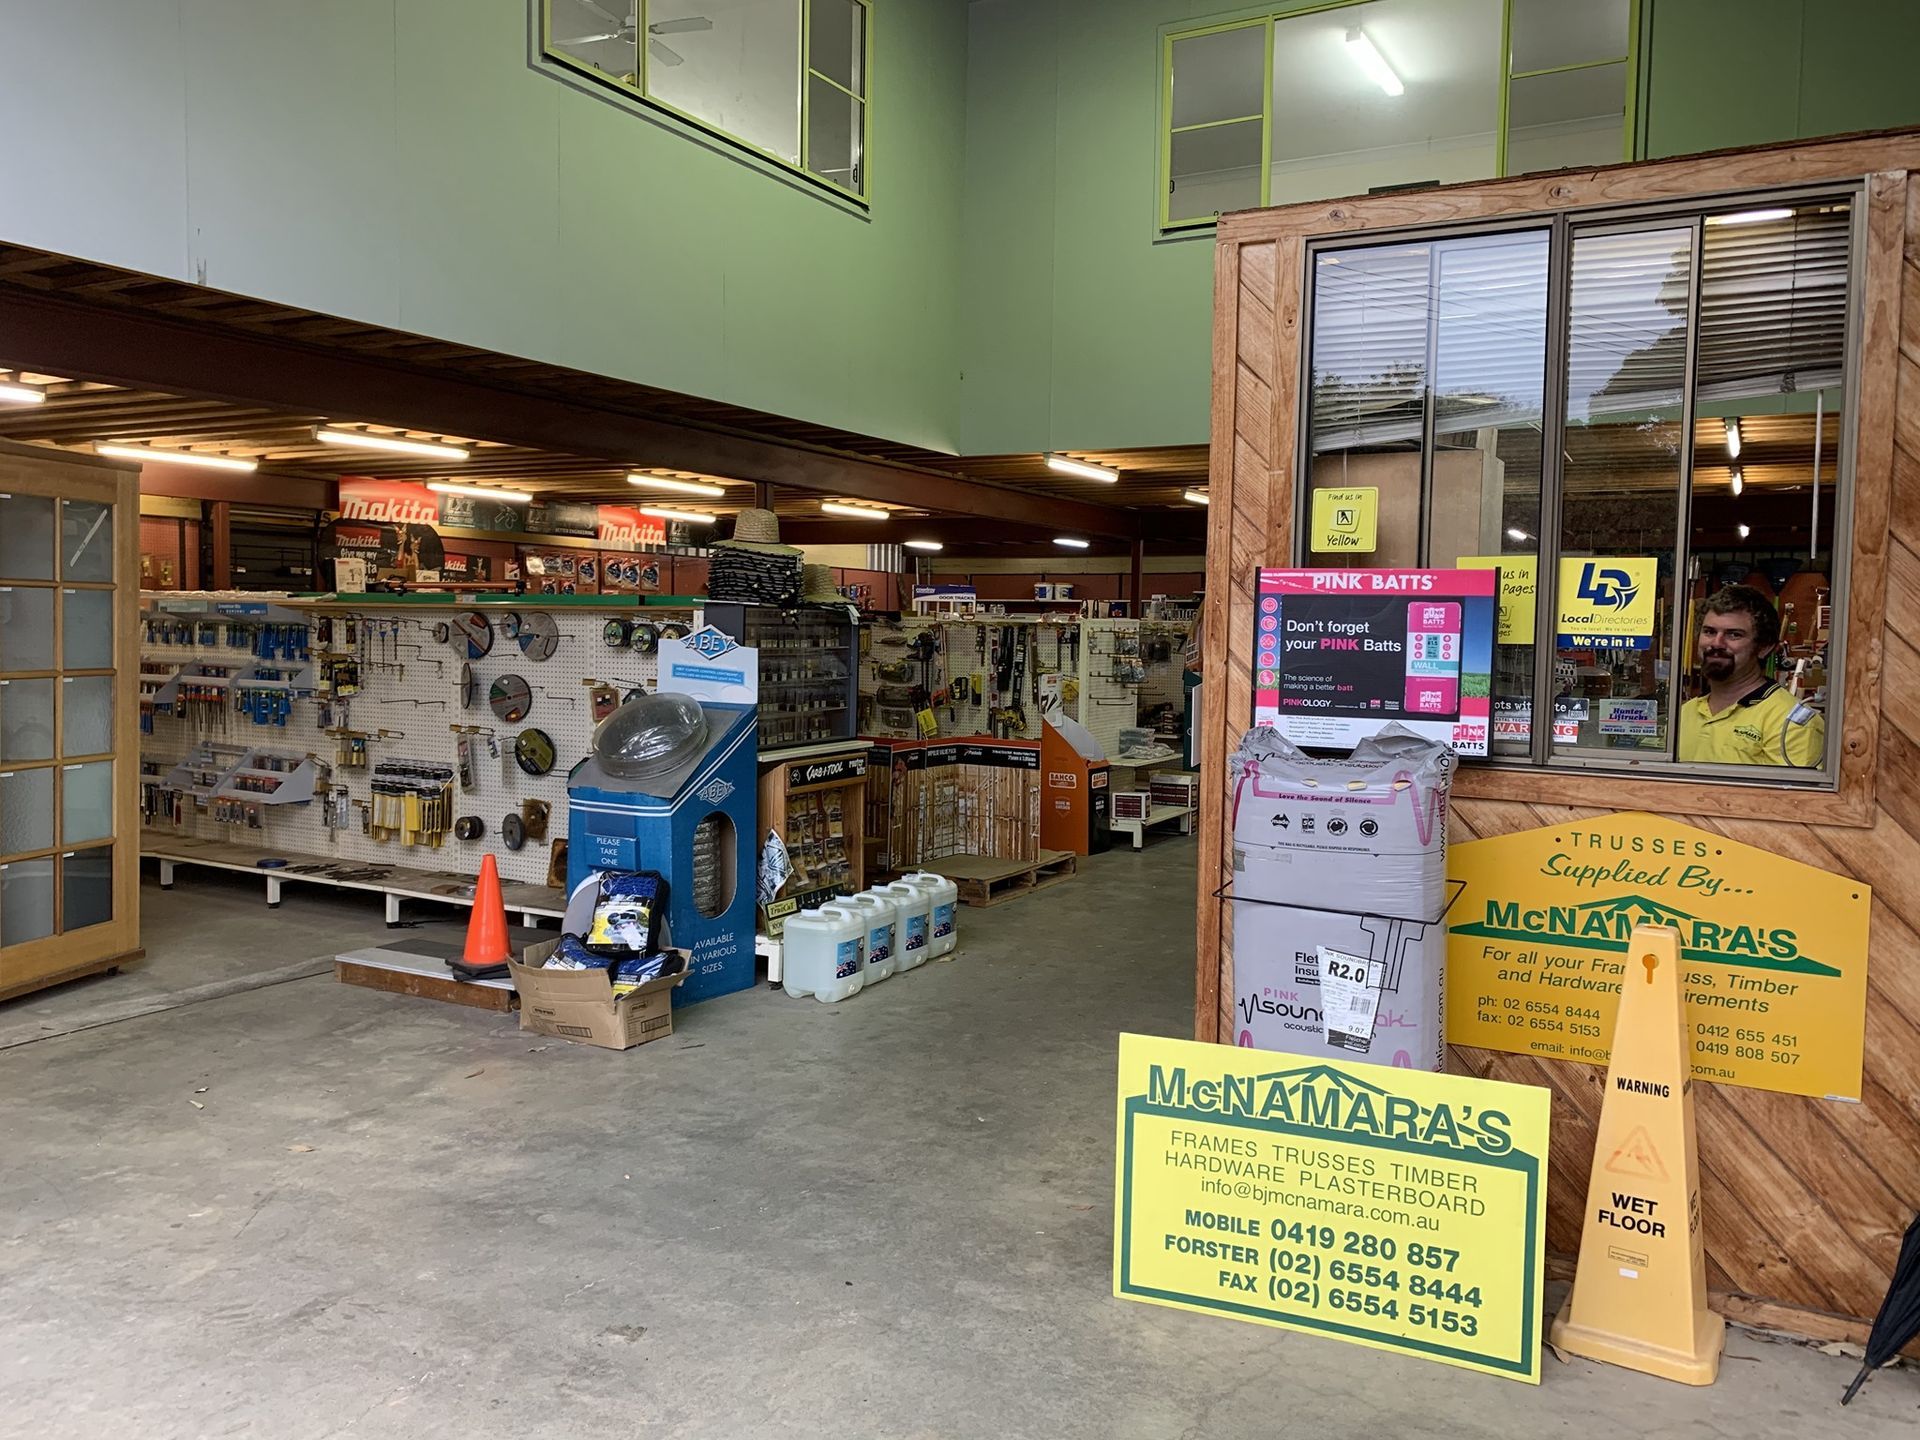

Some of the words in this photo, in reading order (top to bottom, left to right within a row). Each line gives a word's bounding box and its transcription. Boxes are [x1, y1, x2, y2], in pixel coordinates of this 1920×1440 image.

[1328, 493, 1344, 501] Find
[1327, 535, 1360, 547] Yellow
[1502, 570, 1515, 580] us
[1518, 569, 1529, 580] in
[1312, 575, 1363, 591] PINK
[1372, 575, 1432, 591] BATTS
[1502, 583, 1534, 597] Pages
[1327, 620, 1370, 636] forget
[686, 634, 735, 653] ABEY
[1285, 640, 1317, 652] your
[1319, 637, 1360, 651] PINK
[1363, 639, 1402, 652] Batts
[1572, 635, 1609, 647] We're
[1611, 636, 1623, 647] in
[1625, 636, 1635, 647] it
[1413, 661, 1439, 669] WALL
[1298, 674, 1324, 682] science
[1325, 674, 1333, 682] of
[1283, 683, 1308, 691] making
[1337, 684, 1354, 692] batt
[1282, 698, 1332, 708] PINKOLOGY
[1494, 700, 1512, 710] ots
[1514, 701, 1532, 711] wit
[1554, 702, 1567, 712] te
[1453, 727, 1485, 737] PINK
[1493, 723, 1529, 733] WAR
[1553, 726, 1574, 735] NG
[1452, 741, 1485, 750] BATTS
[1050, 773, 1074, 782] BAHCO
[597, 837, 620, 847] PLEASE
[1571, 832, 1707, 857] TRUSSES
[600, 847, 618, 856] TAKE
[601, 857, 618, 866] ONE
[1540, 853, 1671, 888] Supplied
[693, 932, 734, 950] AVAILABLE
[690, 954, 699, 965] IN
[702, 944, 737, 962] VARIOUS
[1295, 951, 1319, 964] Flet
[1295, 965, 1319, 977] Insu
[1328, 961, 1365, 983] R2.0
[1483, 945, 1511, 961] For
[1517, 951, 1538, 965] all
[1544, 956, 1585, 970] your
[1727, 974, 1799, 996] Timber
[1264, 987, 1299, 1002] PINK
[1497, 969, 1532, 983] and
[1539, 971, 1623, 995] Hardware
[1684, 989, 1770, 1013] irements
[1478, 995, 1498, 1008] ph:
[1503, 998, 1520, 1010] 02
[1525, 1001, 1559, 1015] 6554
[1565, 1006, 1600, 1021] 8444
[1284, 1023, 1324, 1034] acoustic
[1477, 1010, 1502, 1024] fax:
[1507, 1015, 1525, 1027] 02
[1530, 1017, 1564, 1032] 6554
[1569, 1023, 1601, 1038] 5153
[1696, 1023, 1730, 1039] 0412
[1735, 1028, 1765, 1043] 655
[1771, 1034, 1798, 1048] 451
[1530, 1040, 1565, 1054] email:
[1569, 1046, 1612, 1061] info@b
[1690, 1064, 1736, 1079] com.au
[1695, 1040, 1729, 1056] 0419
[1735, 1046, 1765, 1060] 808
[1771, 1051, 1800, 1065] 507
[1616, 1076, 1670, 1098] WARNING
[1149, 1063, 1512, 1154] McNAMARA'S
[1171, 1130, 1258, 1158] FRAMES
[1271, 1144, 1376, 1176] TRUSSES
[1390, 1162, 1478, 1194] TIMBER
[1165, 1150, 1286, 1184] HARDWARE
[1300, 1169, 1486, 1217] PLASTERBOARD
[1201, 1177, 1440, 1231] info@bjmcnamara.com.au
[1611, 1191, 1658, 1217] WET
[1598, 1209, 1666, 1239] FLOOR
[1185, 1208, 1261, 1238] MOBILE
[1271, 1218, 1336, 1250] 0419
[1343, 1231, 1397, 1261] 280
[1407, 1242, 1460, 1273] 857
[1165, 1234, 1260, 1266] FORSTER
[1269, 1247, 1321, 1281] (02)
[1329, 1259, 1400, 1292] 6554
[1408, 1274, 1483, 1309] 8444
[1219, 1270, 1258, 1293] FAX
[1268, 1275, 1320, 1309] (02)
[1328, 1287, 1400, 1321] 6554
[1408, 1303, 1479, 1338] 5153
